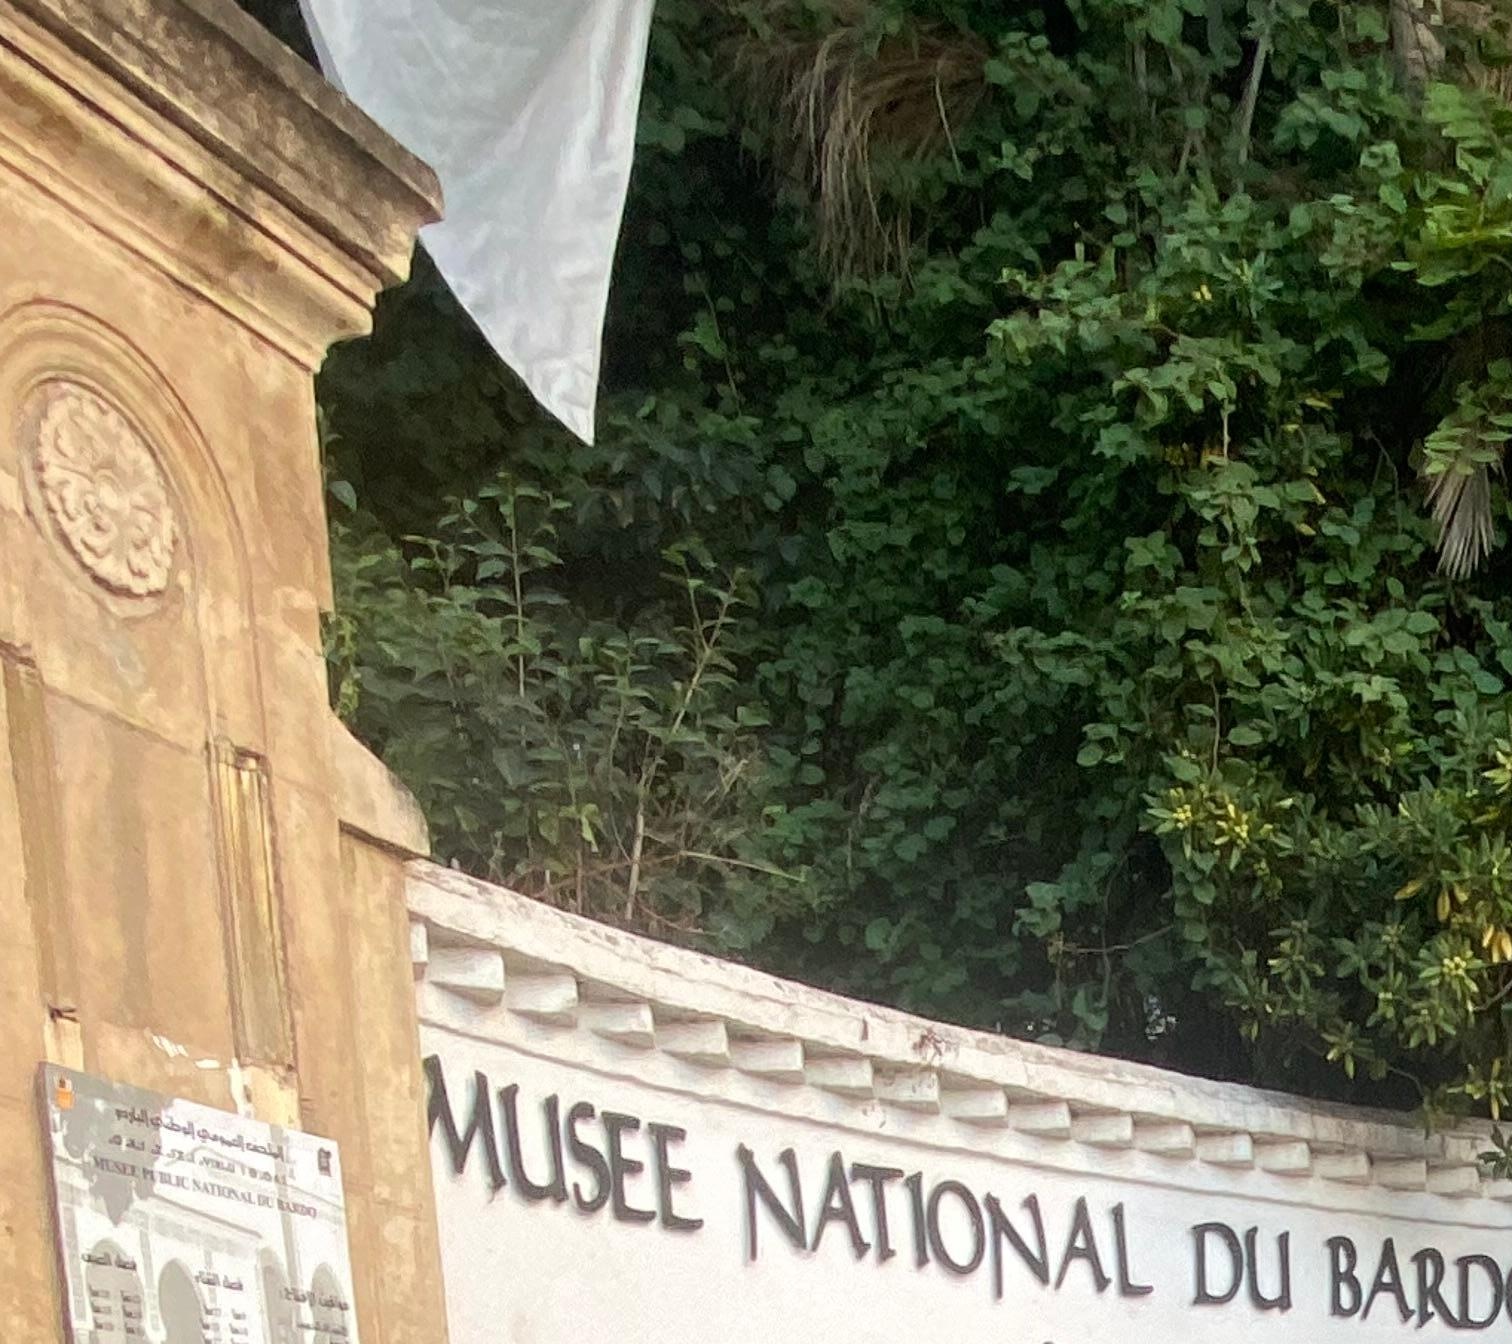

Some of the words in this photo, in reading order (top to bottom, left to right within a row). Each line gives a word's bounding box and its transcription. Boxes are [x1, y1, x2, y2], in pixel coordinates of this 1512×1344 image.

[92, 1154, 138, 1179] MUSEE
[141, 1165, 190, 1191] PUBLIC
[191, 1177, 256, 1206] NATIONAL
[256, 1192, 275, 1209] DU
[422, 1053, 704, 1232] MUSEE
[737, 1142, 1155, 1300] NATIONAL
[1190, 1222, 1293, 1315] DU
